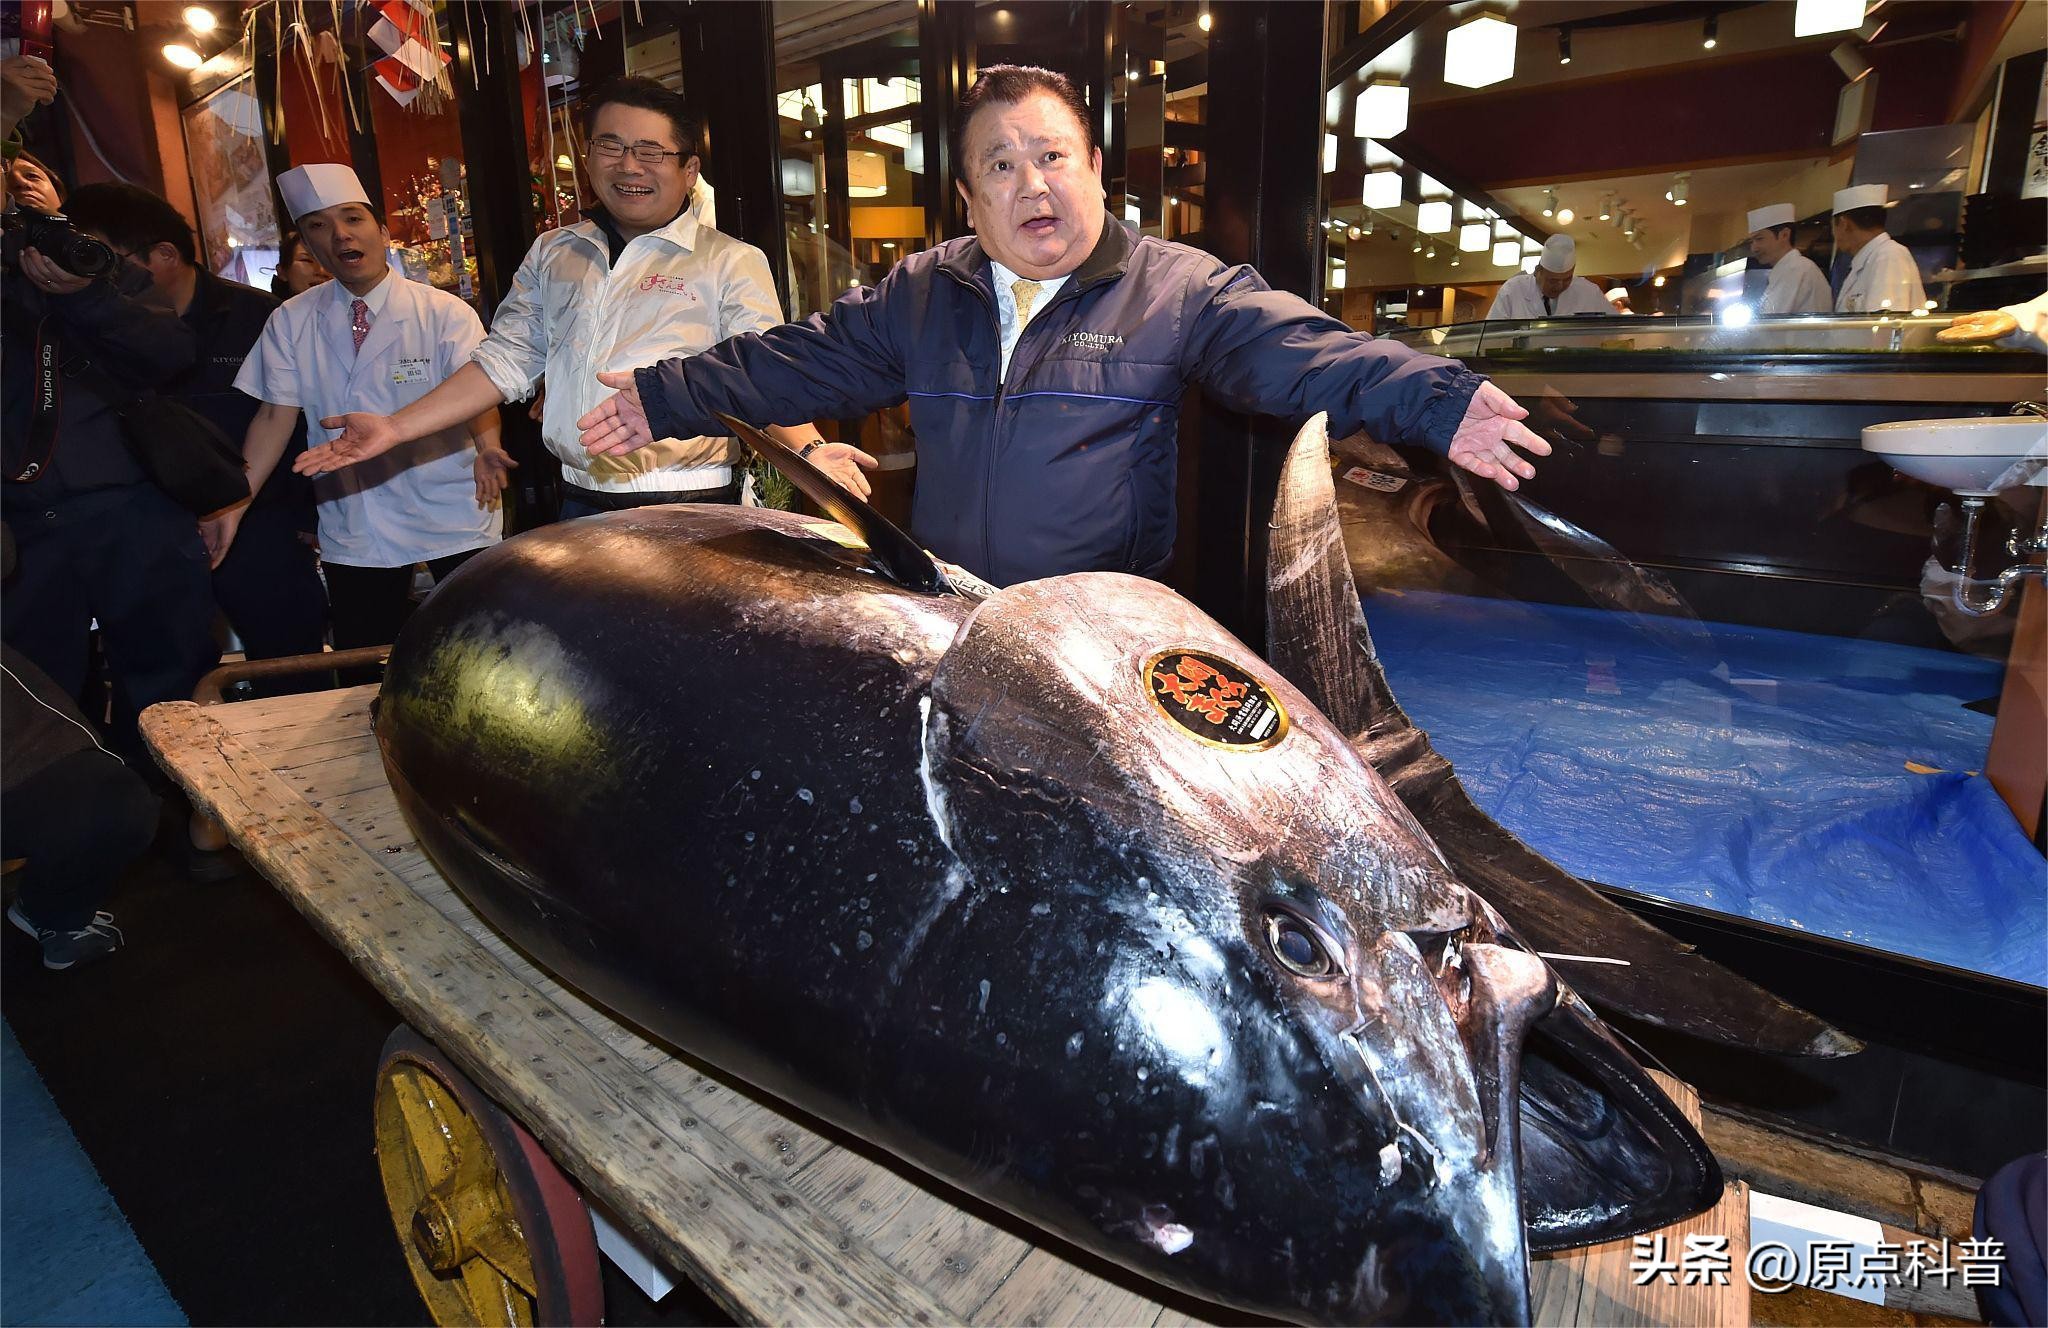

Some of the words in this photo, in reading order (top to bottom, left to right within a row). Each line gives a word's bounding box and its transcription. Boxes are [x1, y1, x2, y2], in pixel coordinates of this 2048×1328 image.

[1061, 332, 1124, 345] KIYOMURA
[42, 344, 52, 367] EOS
[43, 370, 53, 411] DIGITAL
